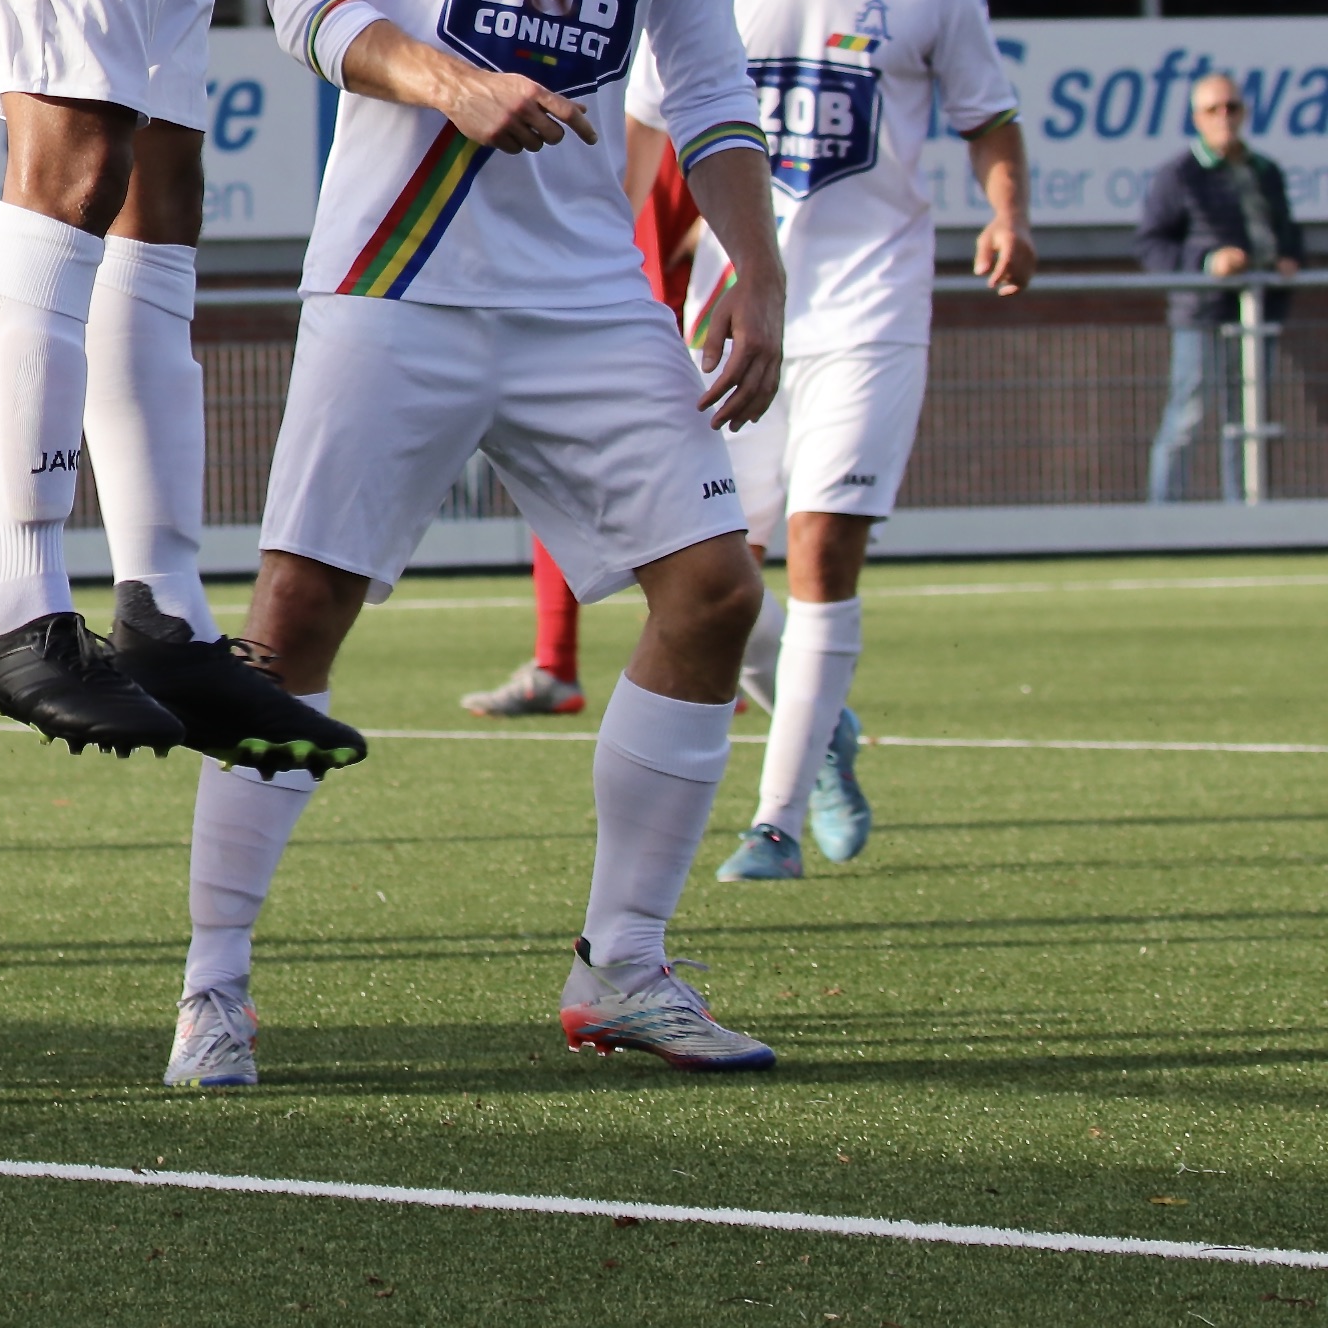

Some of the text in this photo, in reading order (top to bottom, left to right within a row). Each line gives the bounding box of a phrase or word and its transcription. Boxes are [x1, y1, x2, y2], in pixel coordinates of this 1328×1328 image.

[474, 8, 610, 60] CONNECT
[759, 87, 854, 135] ZOB
[767, 133, 852, 159] ONNECT
